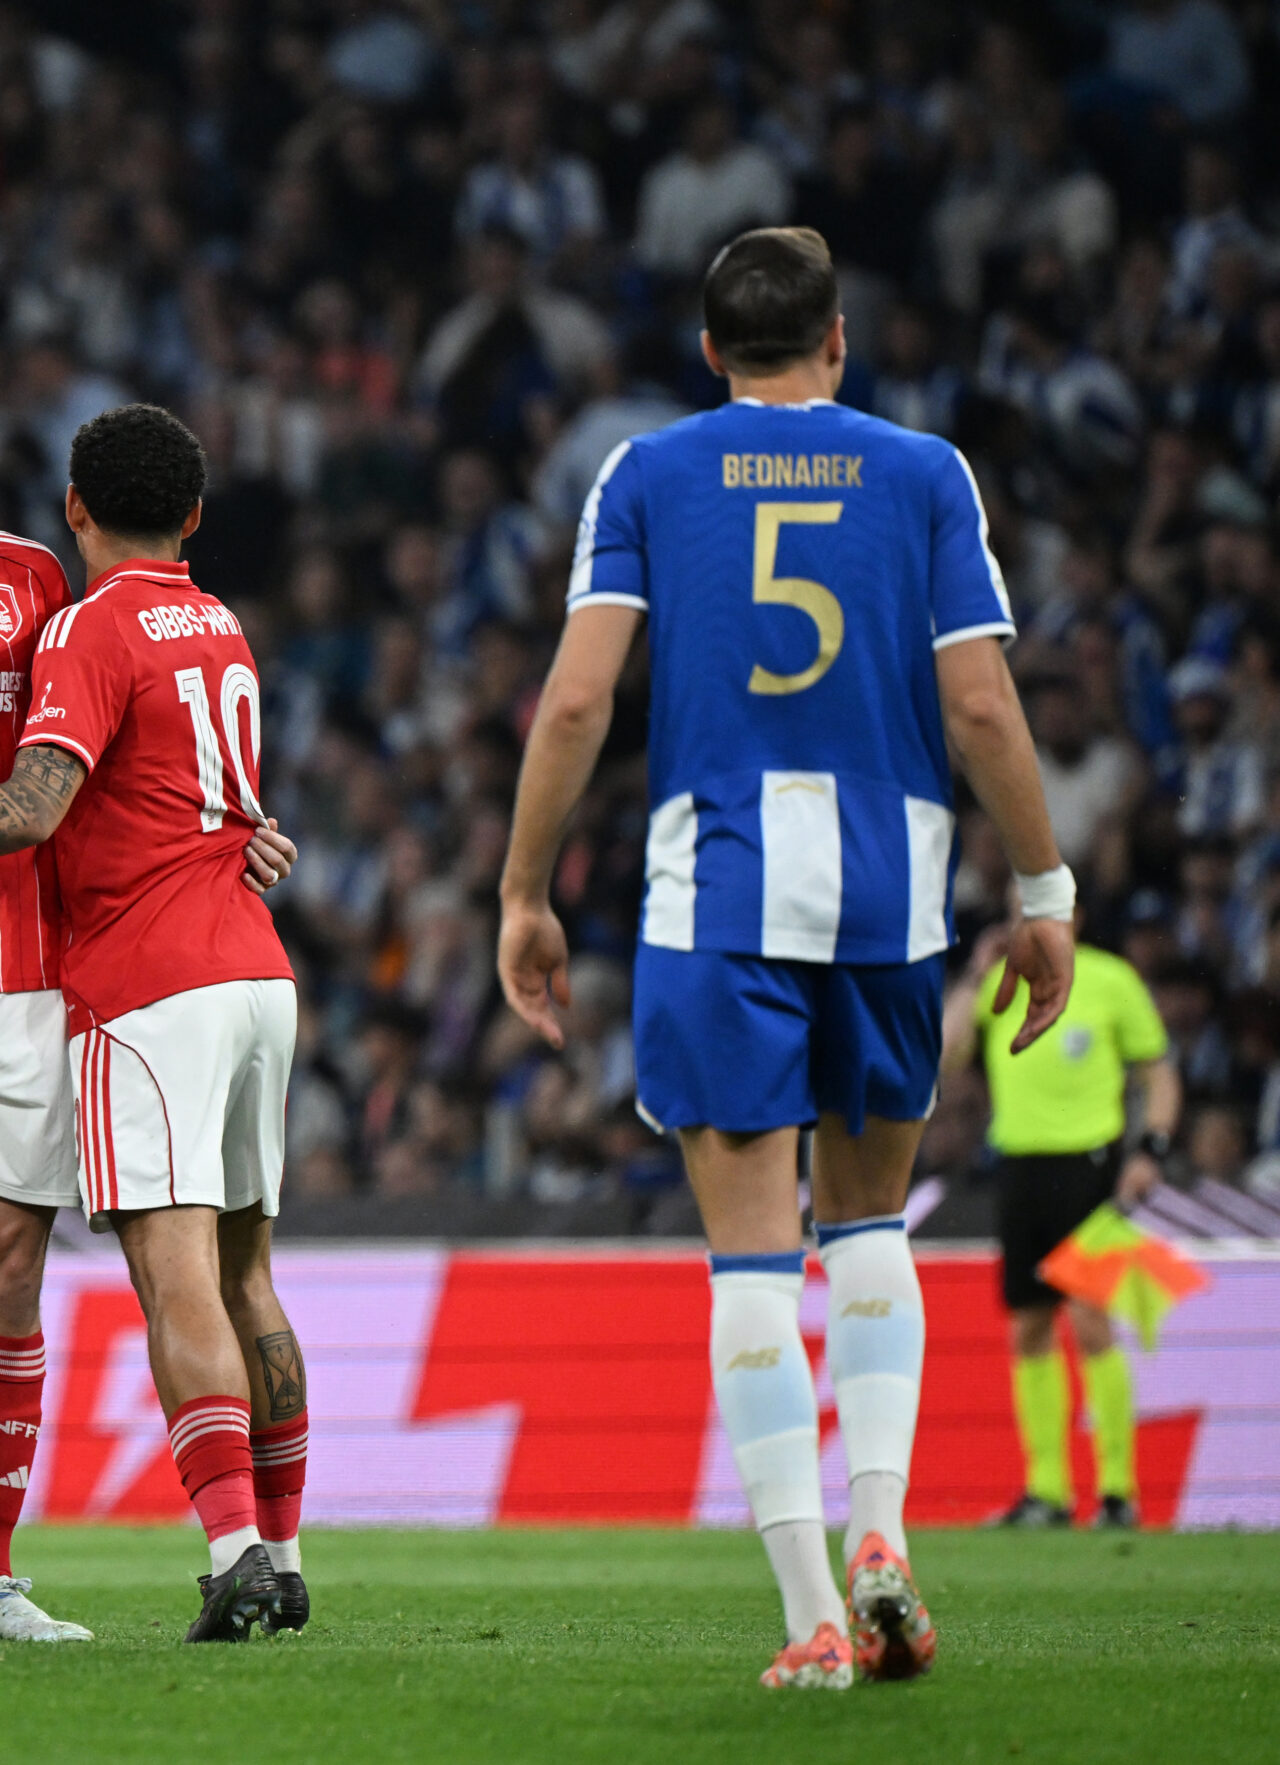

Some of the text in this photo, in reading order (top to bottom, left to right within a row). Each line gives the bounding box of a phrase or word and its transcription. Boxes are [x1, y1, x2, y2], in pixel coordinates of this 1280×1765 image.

[723, 453, 863, 488] BEDNAREK
[138, 604, 242, 642] GIBBS-WHI
[748, 501, 844, 695] 5
[174, 663, 270, 833] 10
